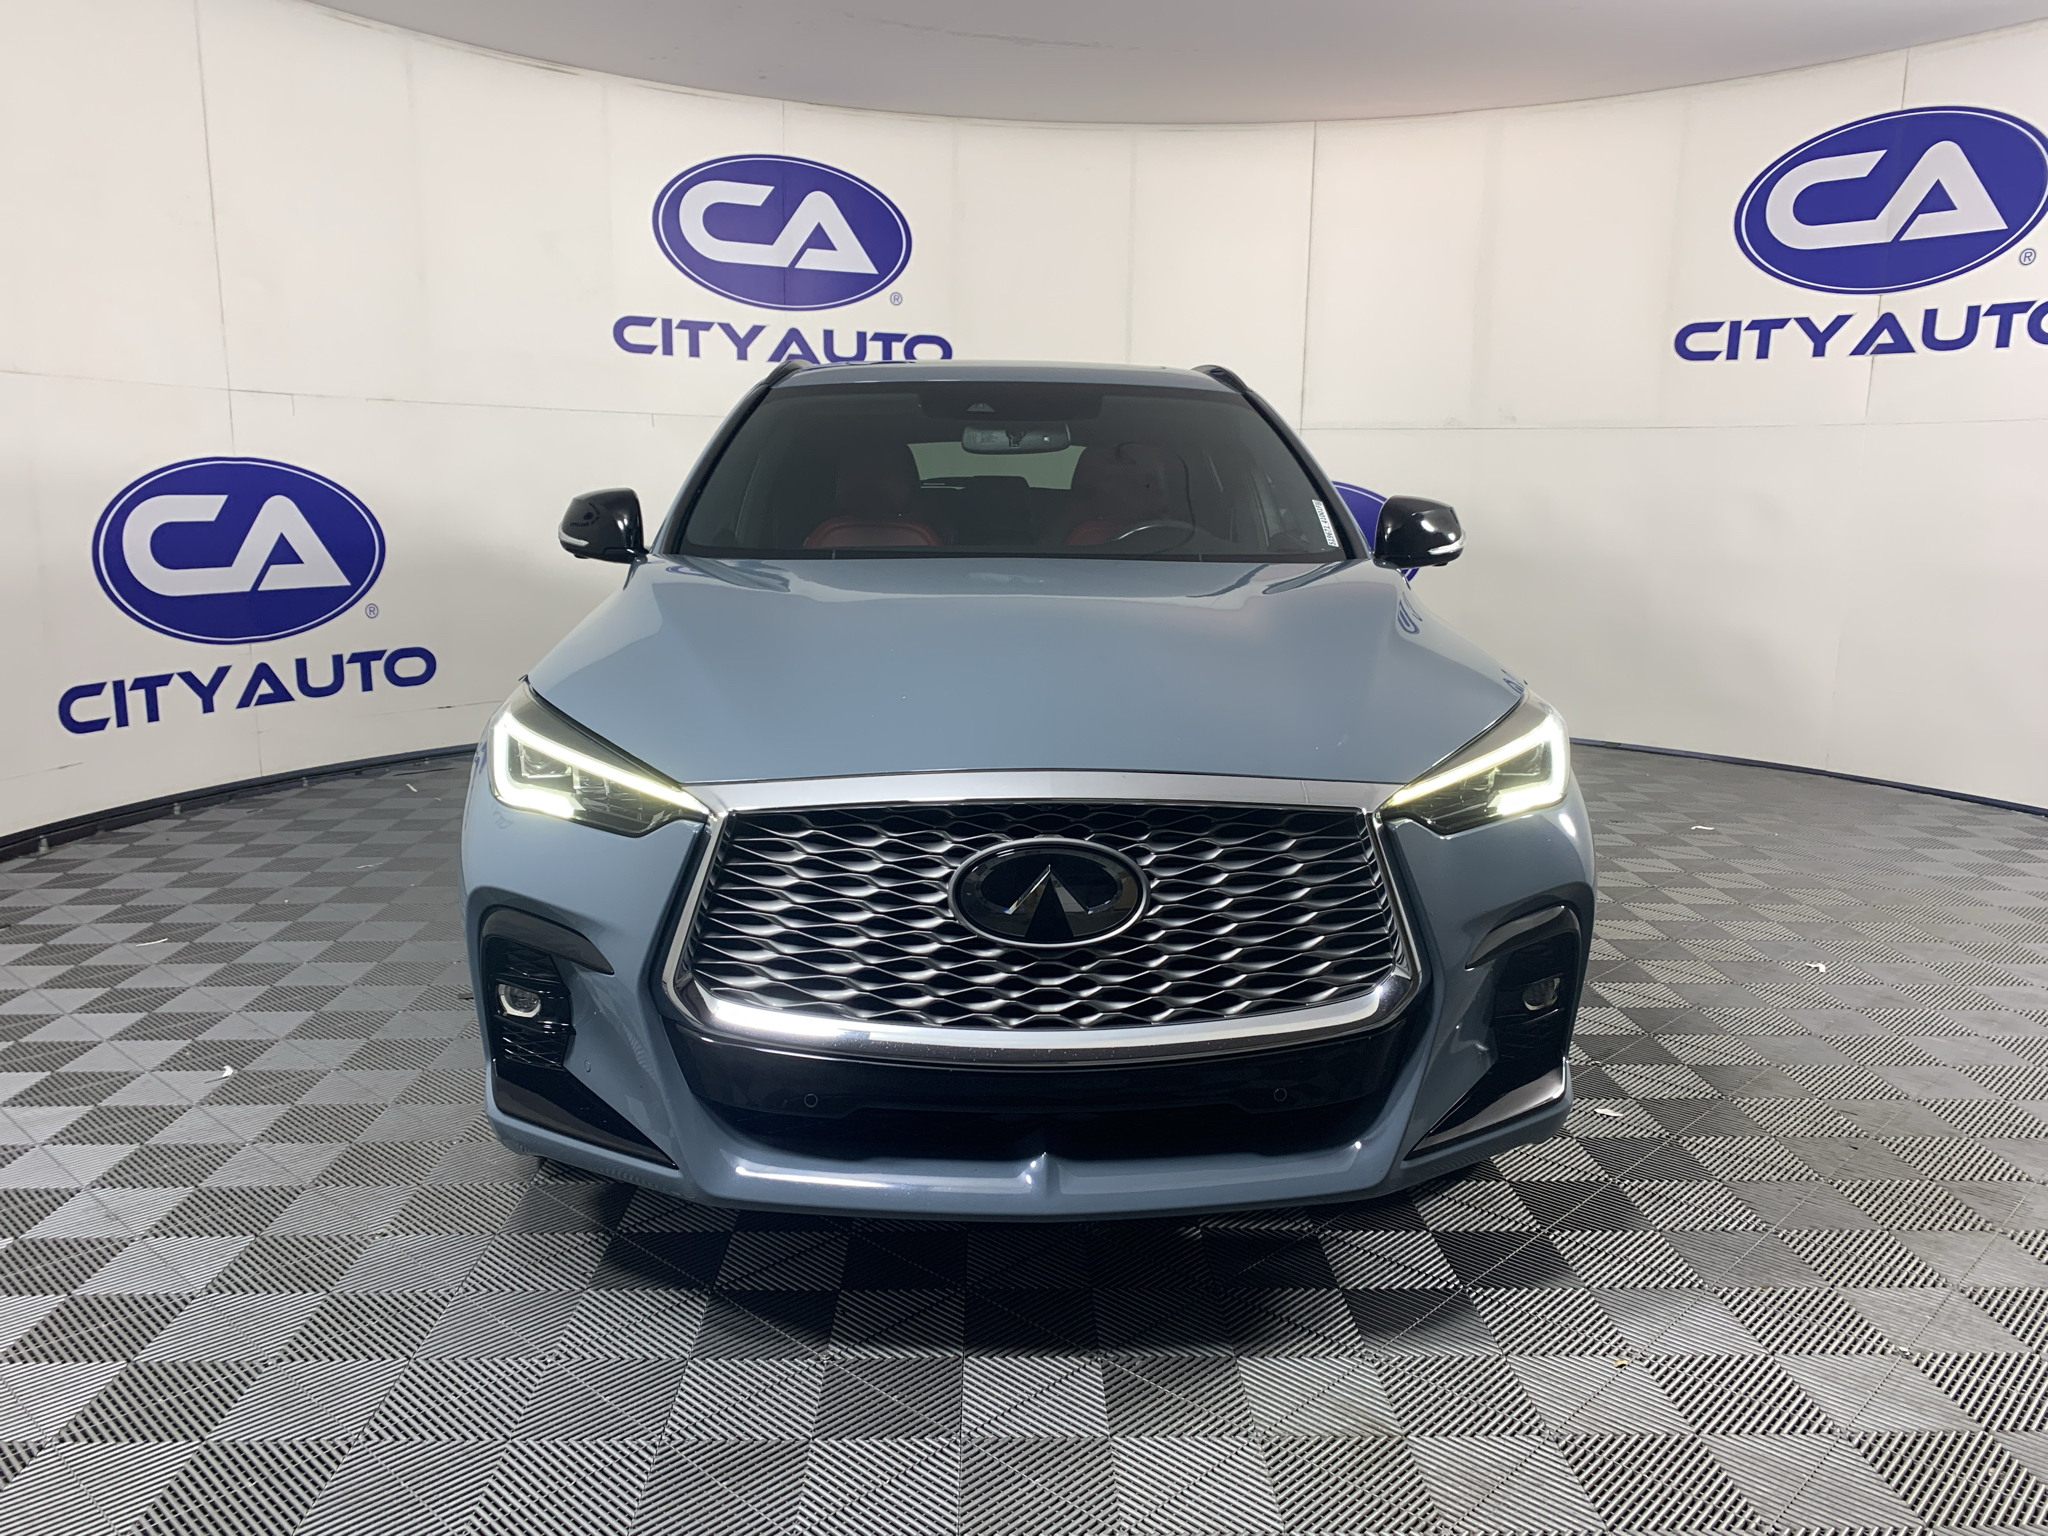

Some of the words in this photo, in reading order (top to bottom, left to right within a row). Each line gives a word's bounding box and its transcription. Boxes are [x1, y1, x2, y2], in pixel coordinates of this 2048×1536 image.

[679, 180, 879, 275] CA
[1766, 140, 2009, 250] CA
[613, 315, 768, 361] CITY
[767, 327, 953, 364] AUTO
[1674, 314, 1854, 361] CITY
[122, 494, 351, 597] CA
[58, 665, 232, 734] CITY
[236, 646, 437, 709] AUTO
